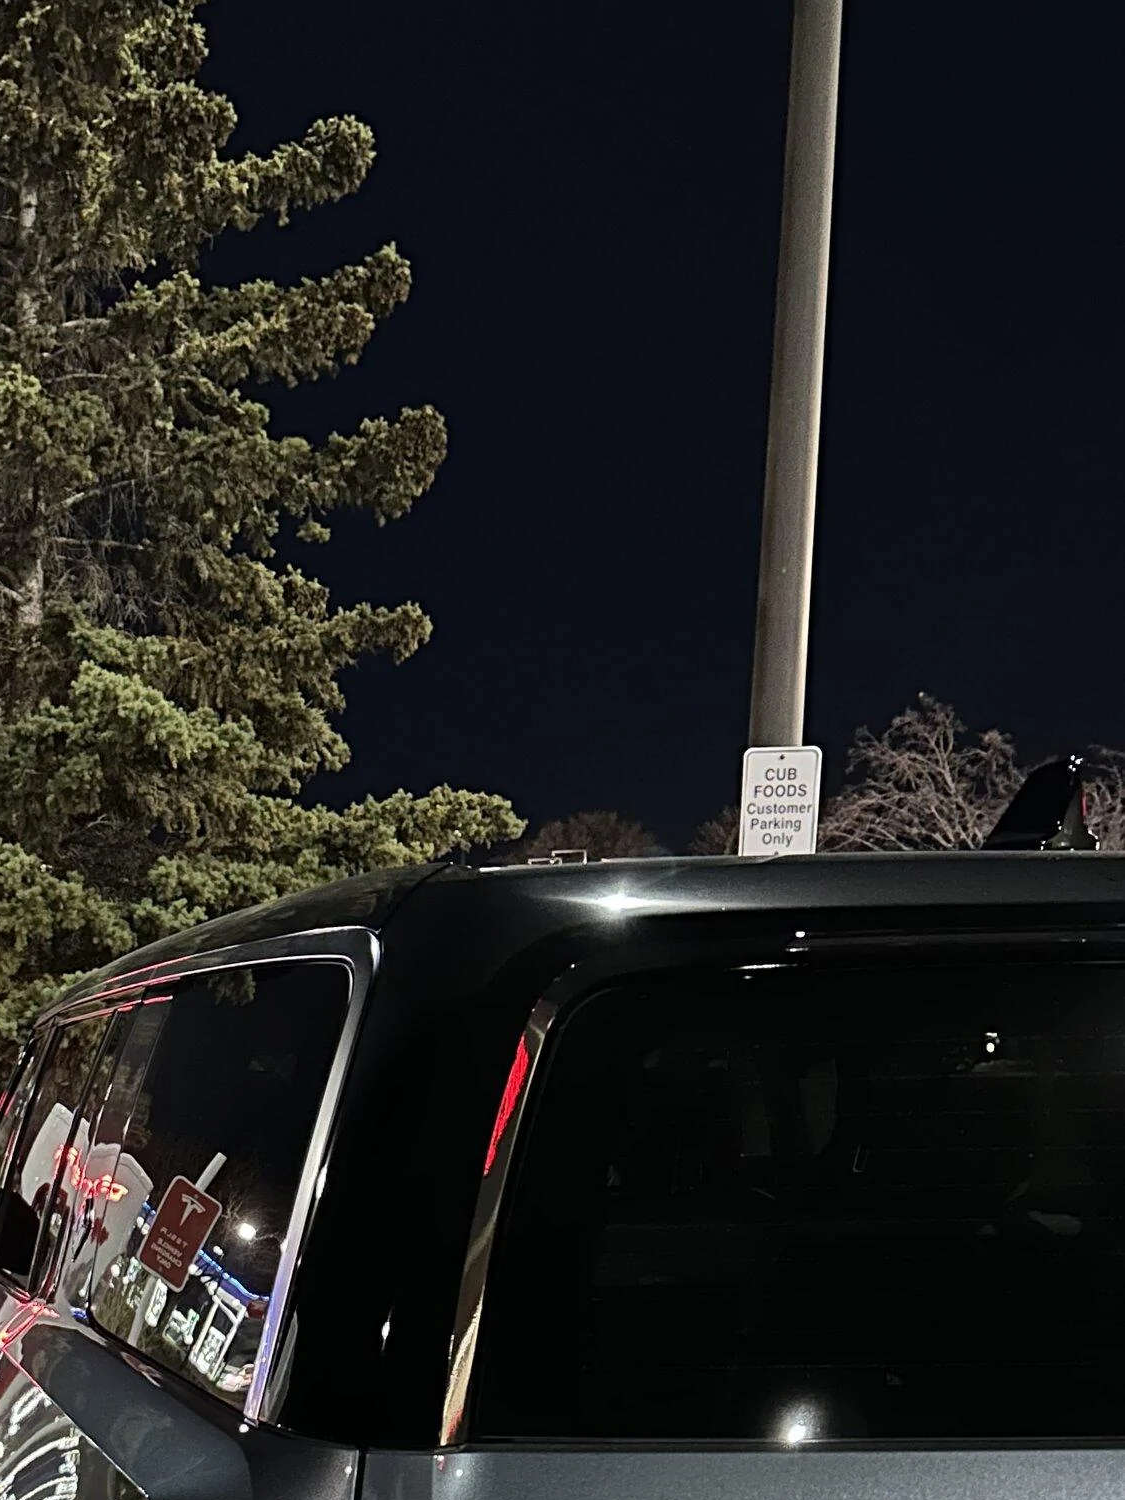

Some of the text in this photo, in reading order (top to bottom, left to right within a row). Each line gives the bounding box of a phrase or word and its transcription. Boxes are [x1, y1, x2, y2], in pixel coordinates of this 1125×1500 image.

[765, 767, 797, 781] CUB
[753, 784, 807, 798] FOODS
[746, 802, 813, 815] Customer
[750, 817, 802, 831] Parking
[761, 833, 794, 847] Only
